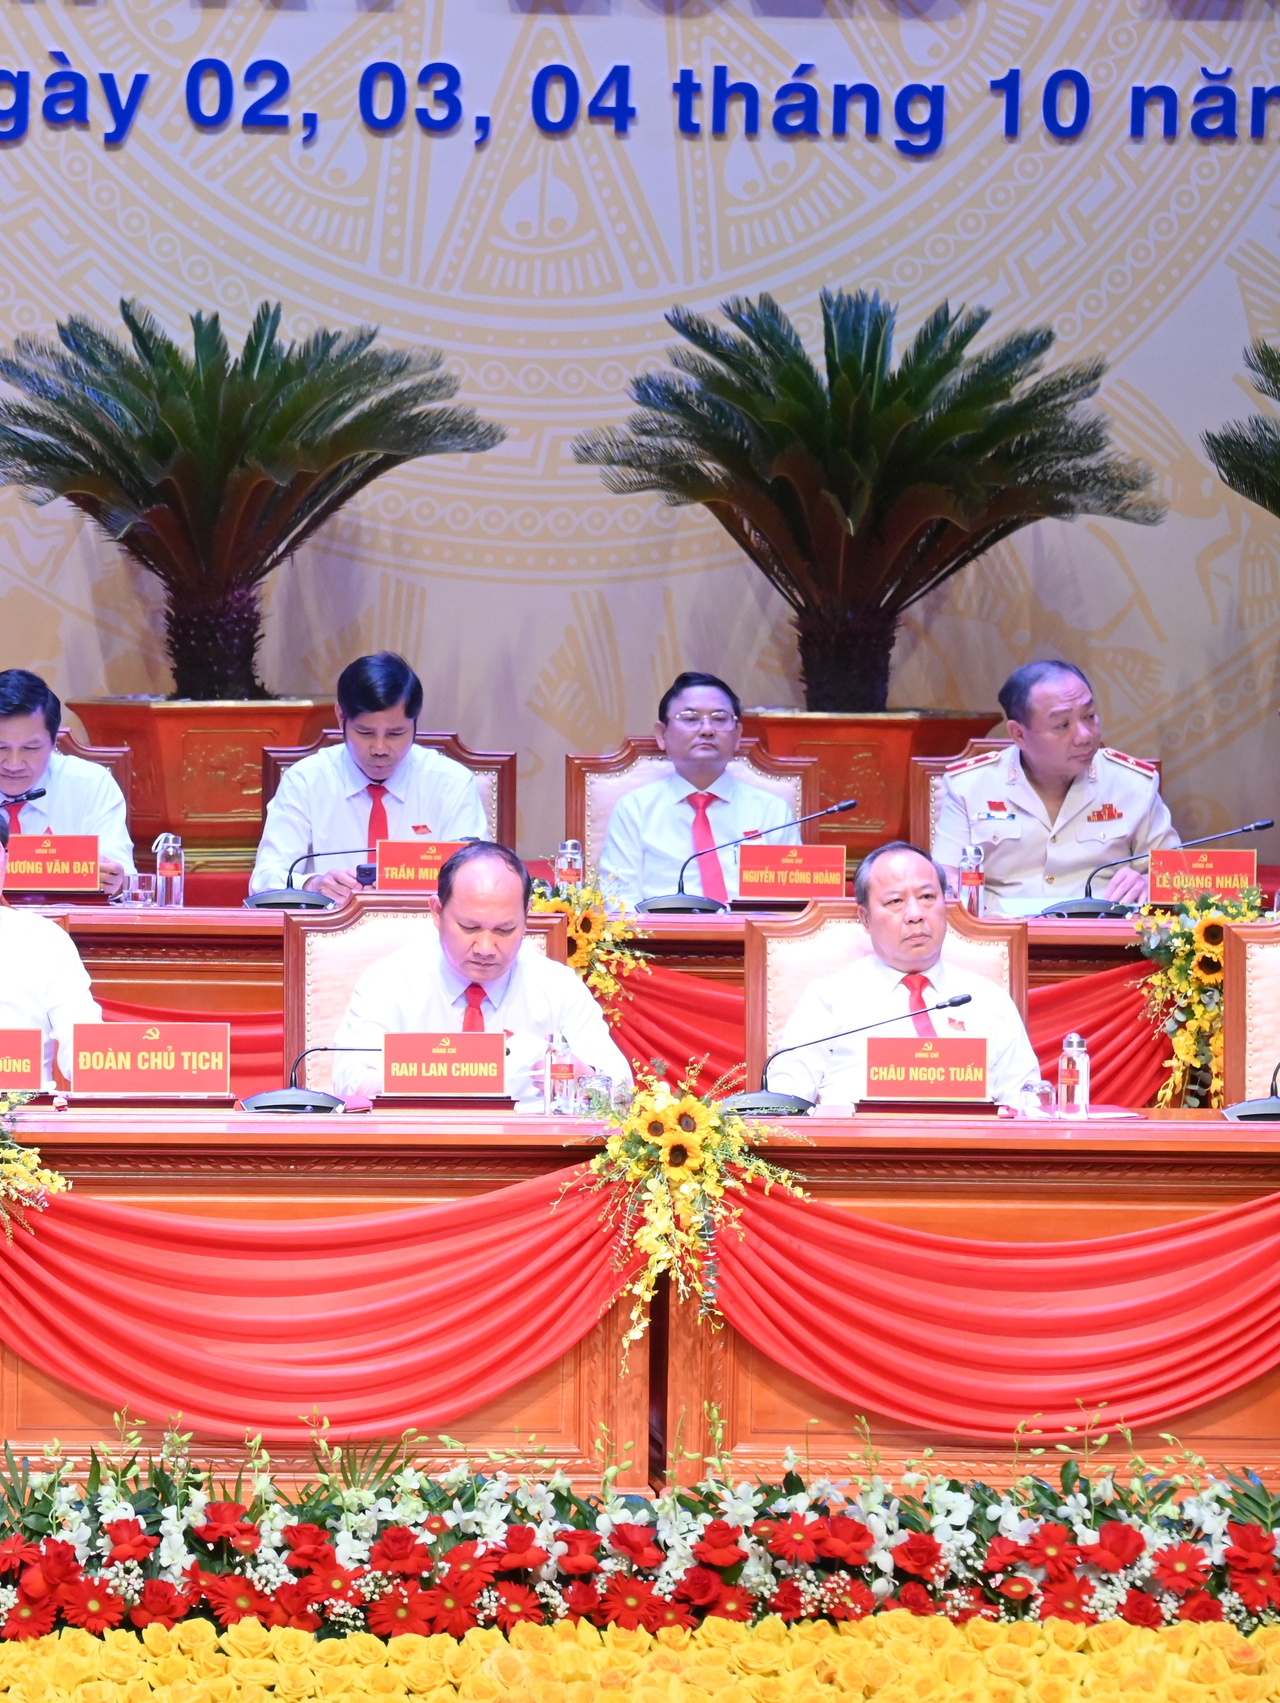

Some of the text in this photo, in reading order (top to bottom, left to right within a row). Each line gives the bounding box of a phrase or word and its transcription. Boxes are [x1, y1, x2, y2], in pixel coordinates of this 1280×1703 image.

[185, 58, 319, 141] 02,
[358, 61, 491, 145] 03,
[530, 64, 638, 133] 04
[671, 63, 947, 154] tháng
[988, 68, 1092, 138] 10
[46, 859, 70, 874] VĂN
[73, 861, 96, 876] ĐẠT
[418, 867, 440, 881] MIN
[742, 866, 775, 883] NGUYỄN
[789, 869, 811, 884] CÔNG
[813, 869, 841, 885] HOÀNG
[1216, 873, 1249, 889] NHÂN
[78, 1045, 223, 1074] ĐOÀN CHỦ TỊCH
[391, 1062, 498, 1077] RAH LAN CHUNG
[870, 1062, 983, 1084] CHÂU NGỌC TUẤN
